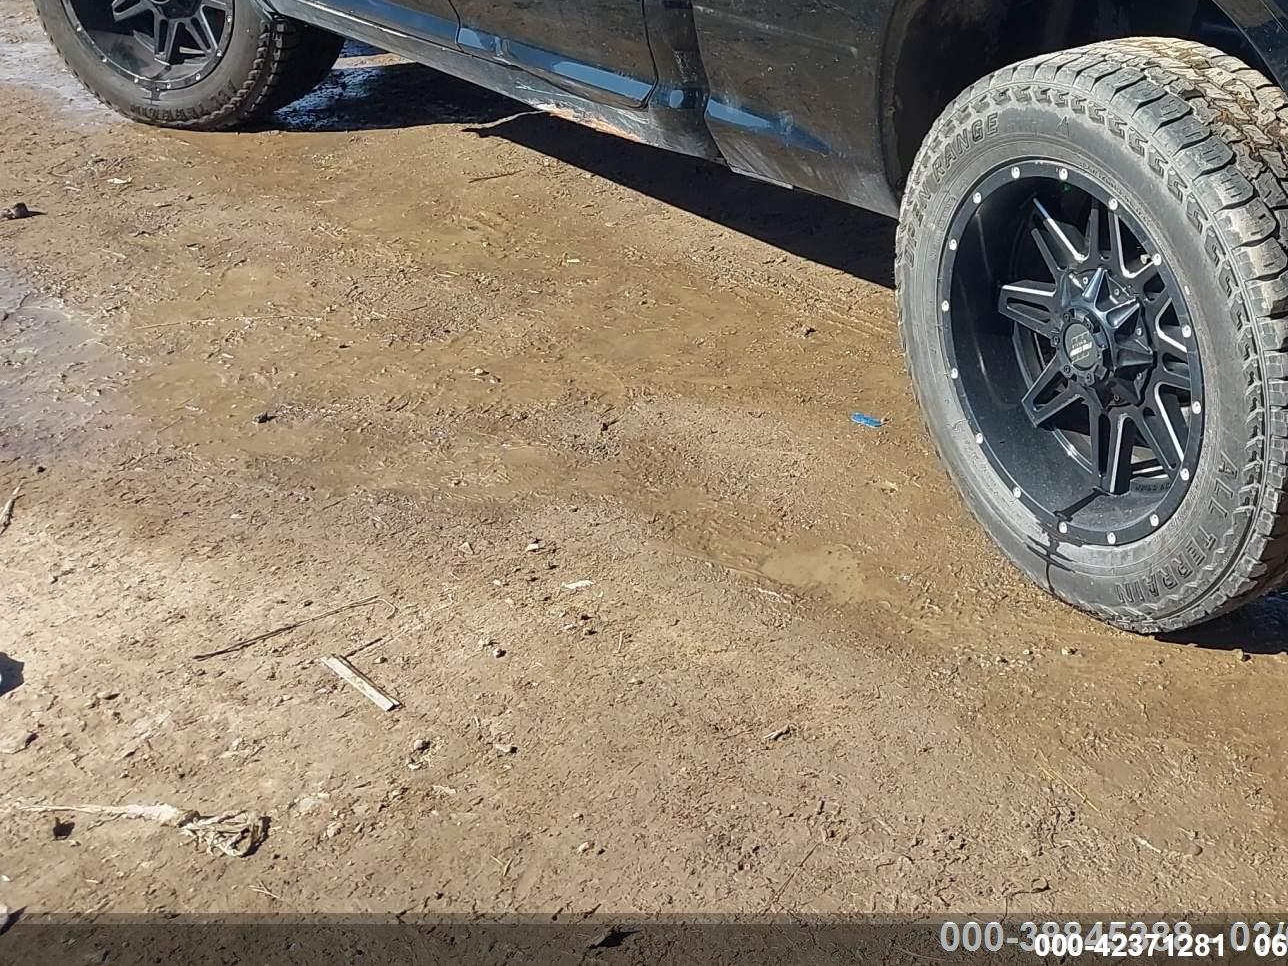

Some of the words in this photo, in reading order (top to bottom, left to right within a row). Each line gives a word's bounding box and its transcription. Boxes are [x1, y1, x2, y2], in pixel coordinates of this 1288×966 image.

[931, 112, 999, 182] RANGE
[1117, 525, 1217, 603] TERRAIN
[1209, 449, 1239, 519] ALL
